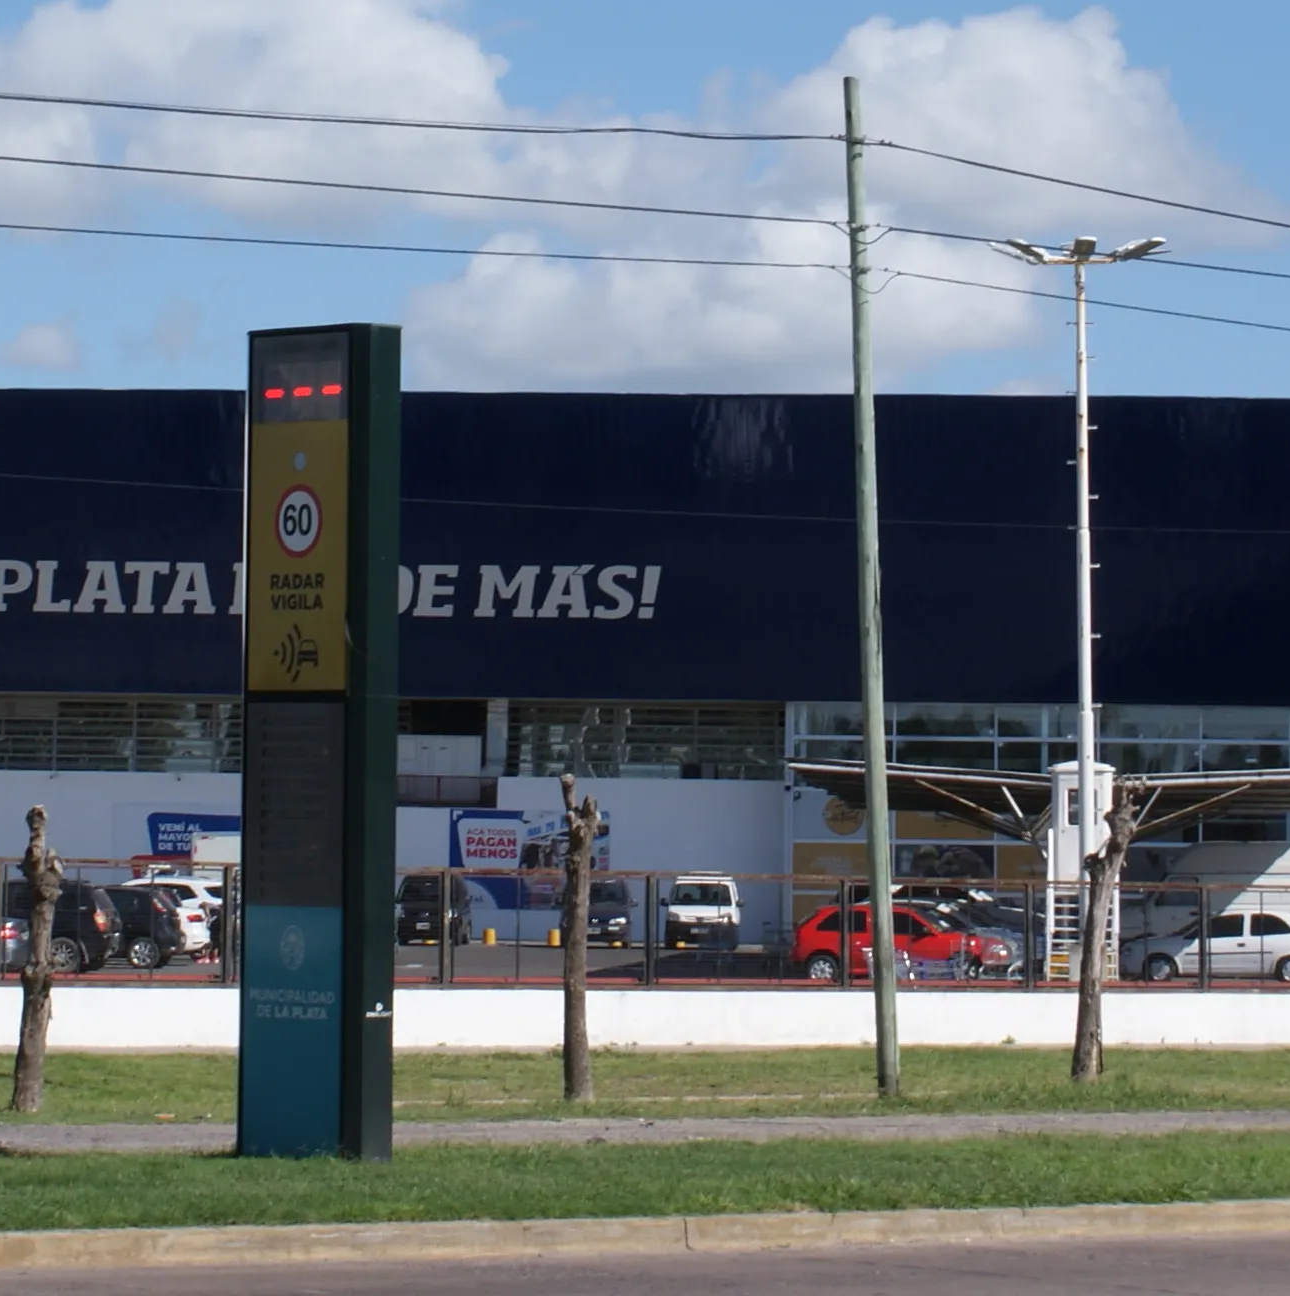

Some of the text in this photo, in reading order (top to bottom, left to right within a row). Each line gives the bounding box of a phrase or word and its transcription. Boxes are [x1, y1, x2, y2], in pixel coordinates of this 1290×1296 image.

[283, 503, 312, 537] 60
[270, 573, 325, 590] RADAR
[473, 564, 662, 620] MÁS!
[270, 594, 323, 611] VIGILA
[187, 823, 203, 832] AL
[487, 828, 517, 837] TODOS
[158, 842, 174, 851] DE
[466, 836, 517, 848] PAGAN
[466, 847, 518, 859] MENOS
[249, 987, 335, 1005] MUNICIPALIDAD
[256, 1004, 328, 1020] DE LA PLATA
